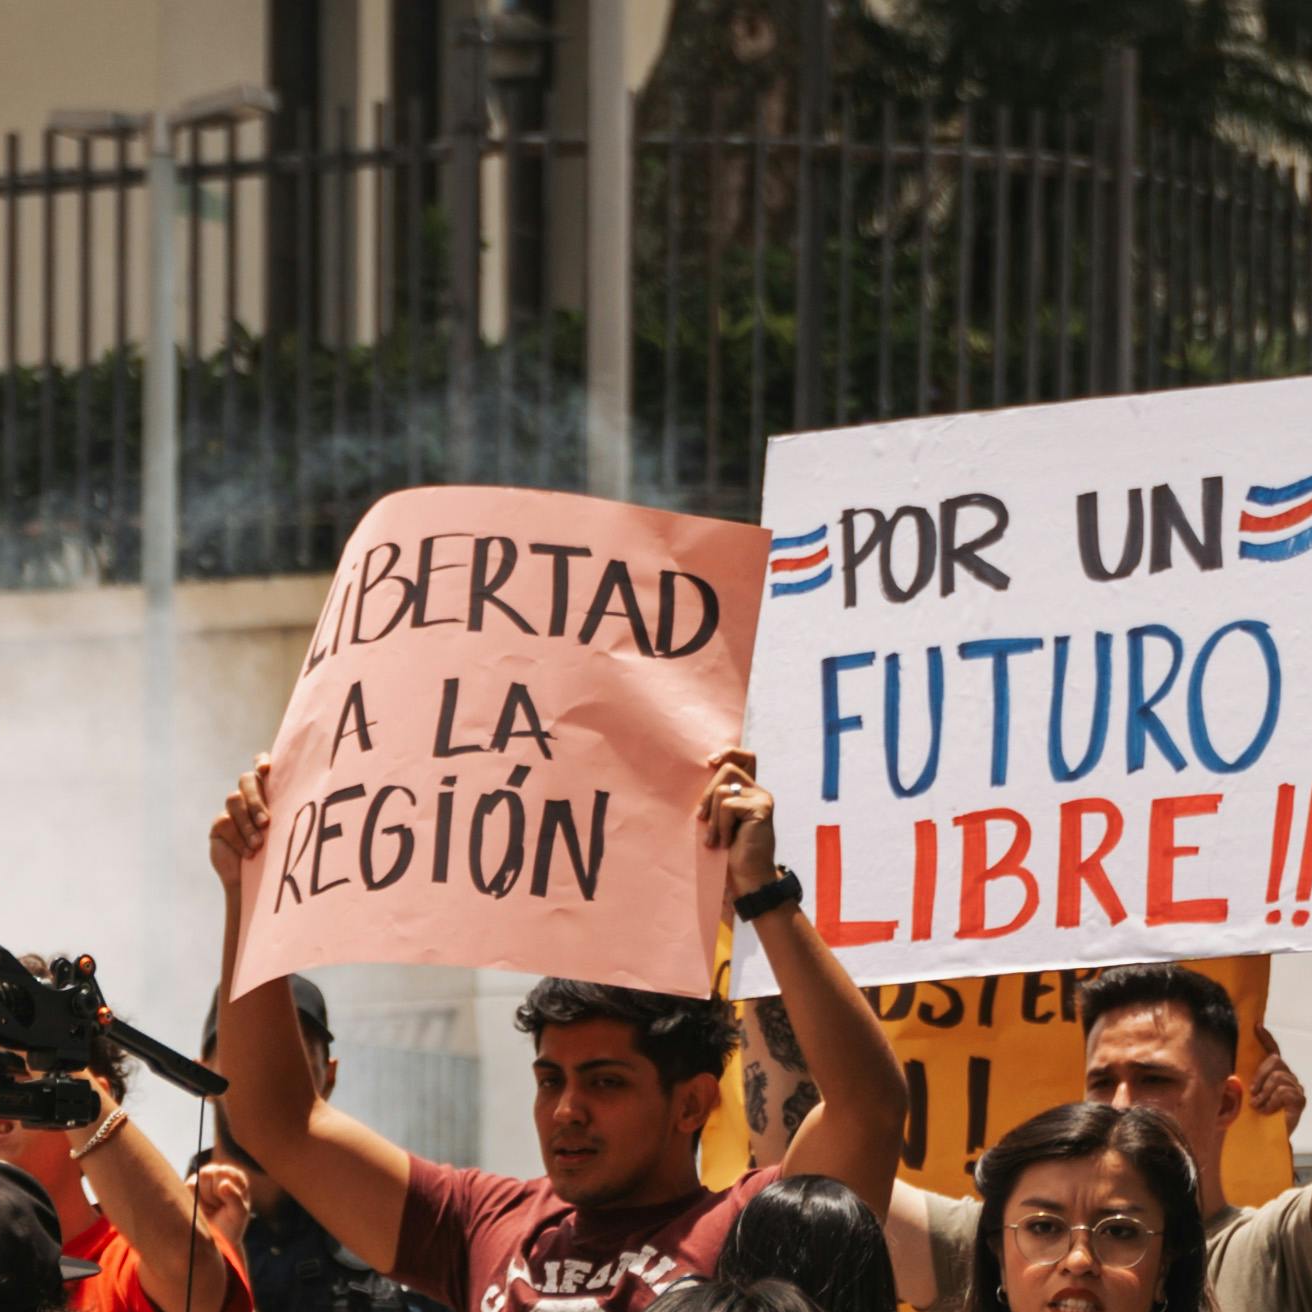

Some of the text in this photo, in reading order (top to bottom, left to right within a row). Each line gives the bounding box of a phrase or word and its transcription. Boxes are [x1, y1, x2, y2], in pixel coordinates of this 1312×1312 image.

[304, 532, 721, 678] LIBERTAD
[839, 475, 1224, 608] POR UN
[329, 677, 557, 769] A LA
[821, 619, 1282, 802] FUTURO
[274, 764, 610, 914] REGIÓN
